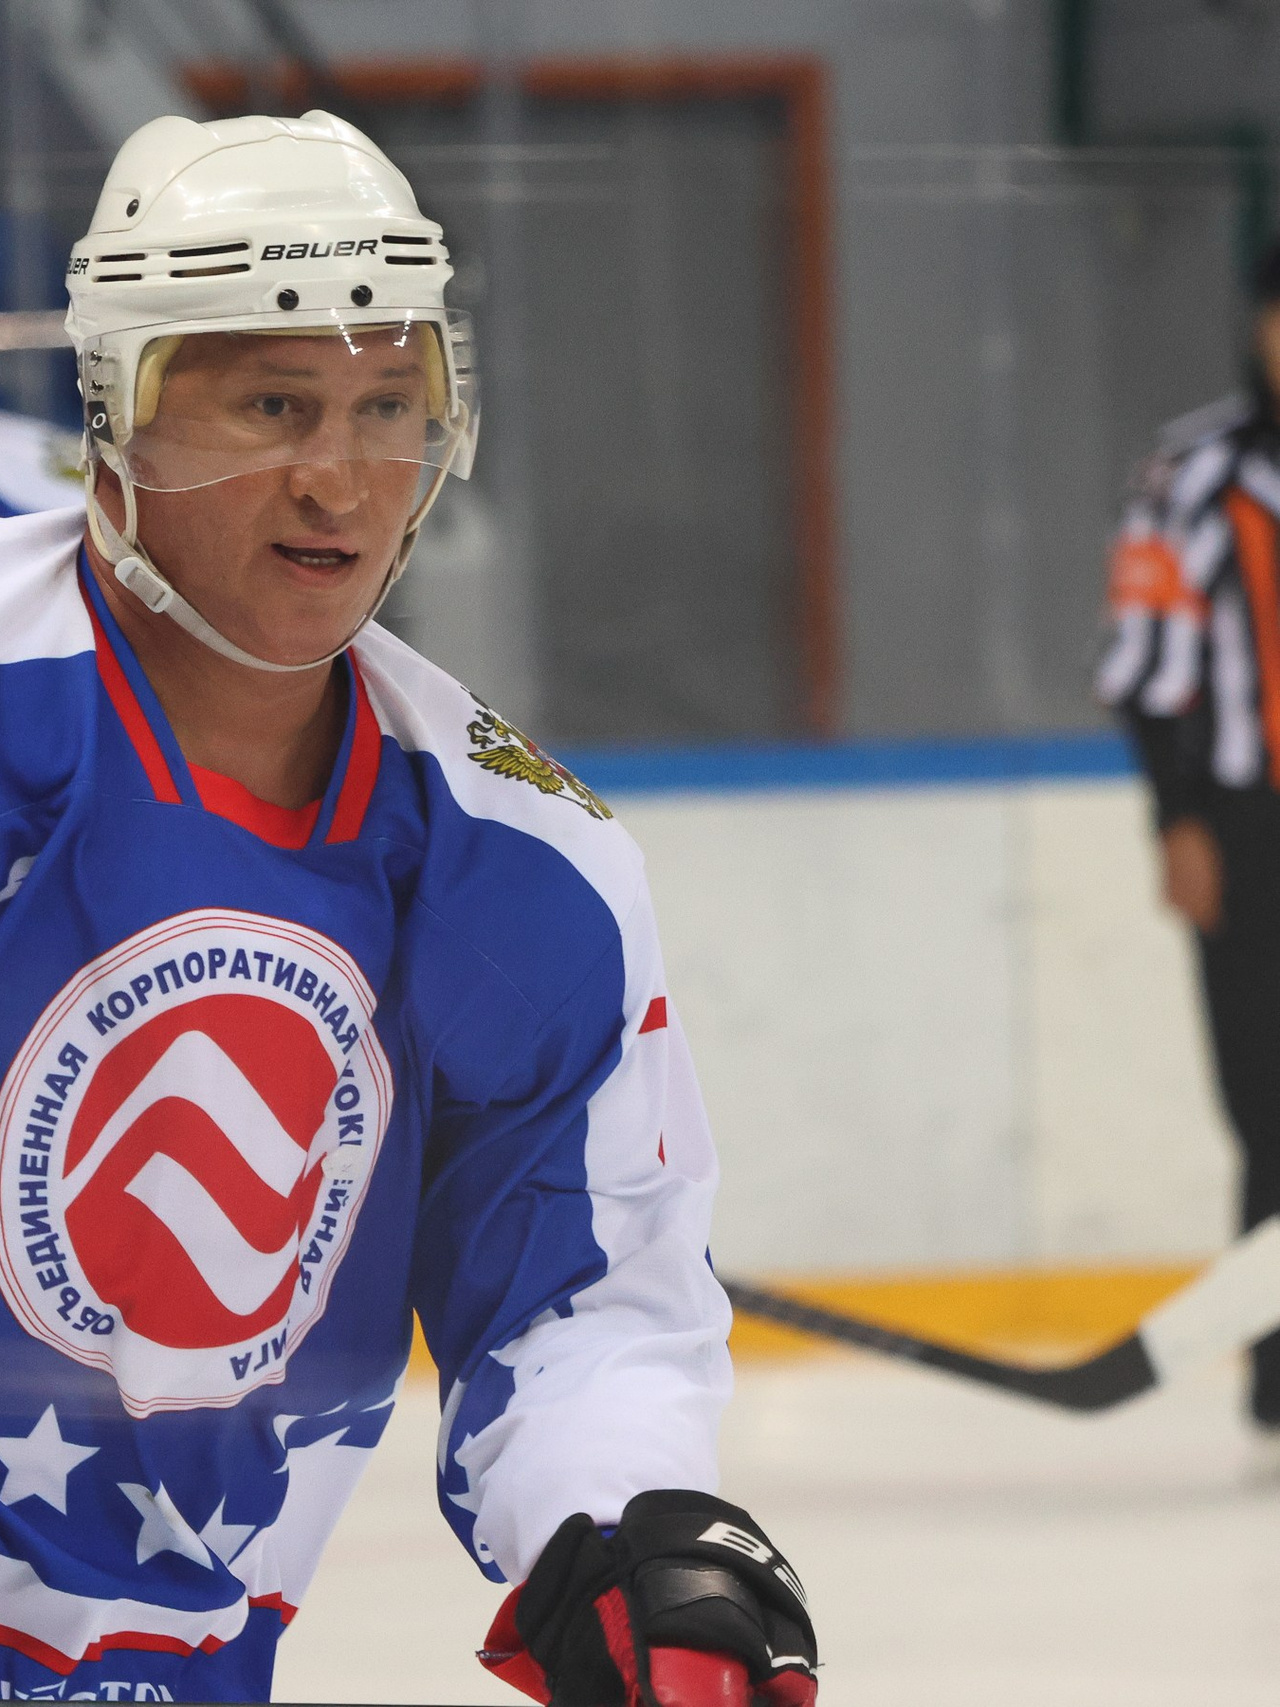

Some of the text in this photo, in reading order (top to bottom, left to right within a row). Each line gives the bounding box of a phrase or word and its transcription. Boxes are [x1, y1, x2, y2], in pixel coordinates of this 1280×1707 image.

[260, 239, 379, 262] BAUER
[19, 1042, 115, 1336] ОБЪЕДИНЕННАЯ
[86, 947, 360, 1055] КОРПОРАТИВНАЯ
